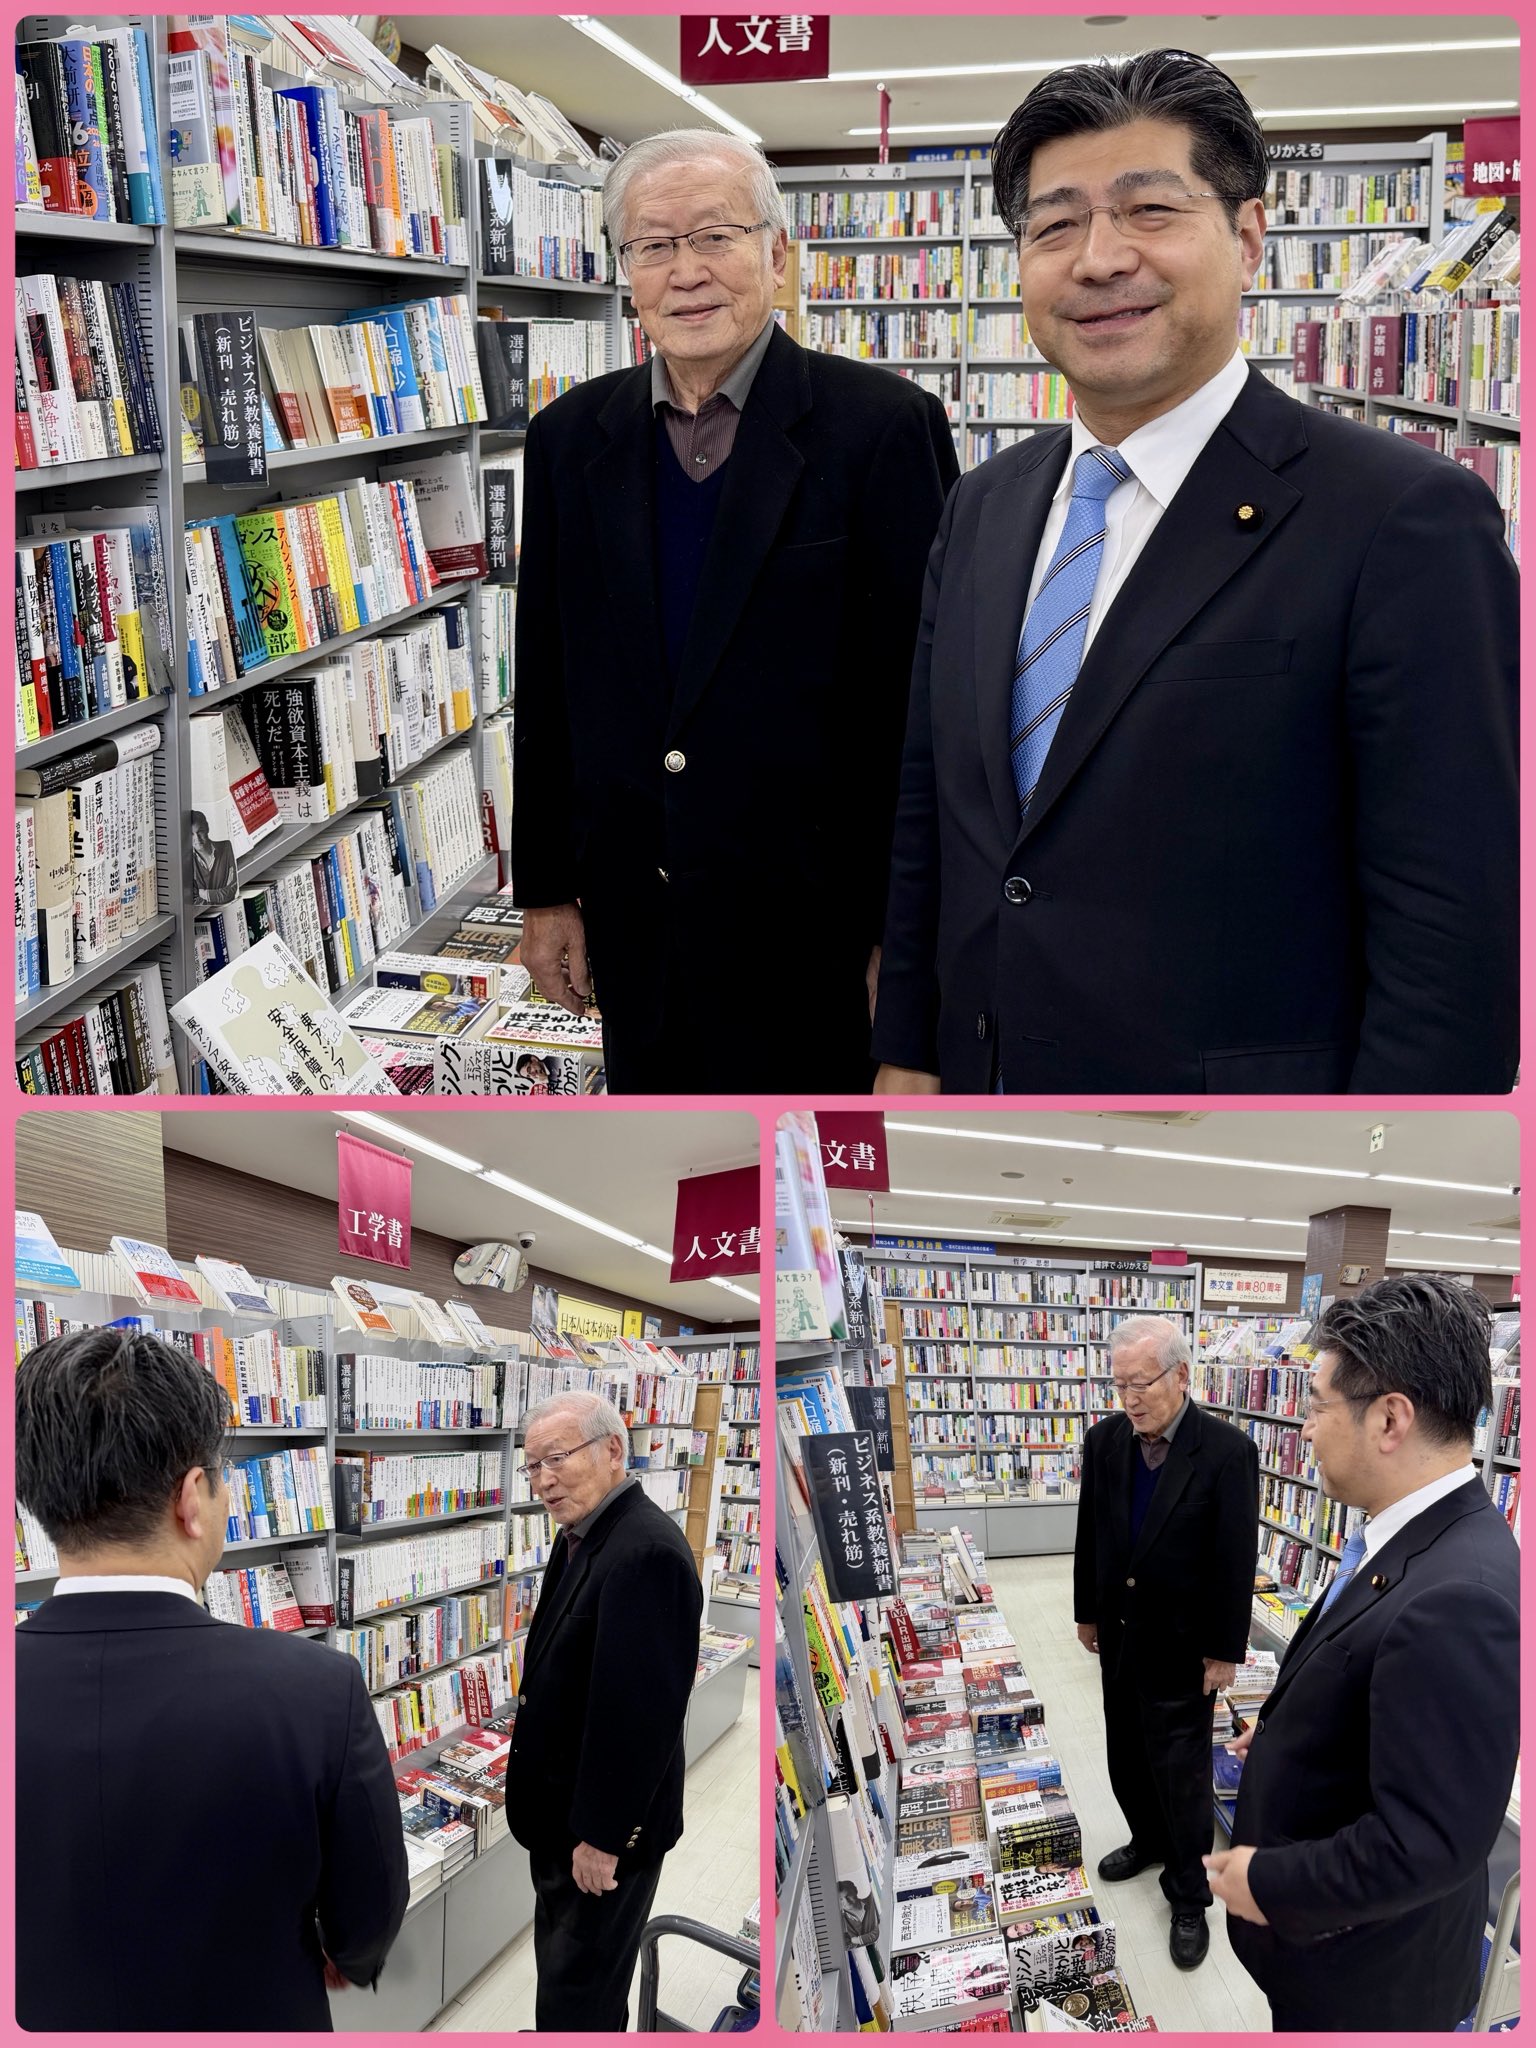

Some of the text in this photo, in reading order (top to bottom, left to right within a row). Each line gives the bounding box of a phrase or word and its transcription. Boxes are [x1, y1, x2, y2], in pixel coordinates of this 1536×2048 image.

[698, 15, 814, 57] 人文書
[839, 166, 903, 180] 人文書
[508, 334, 524, 407] 選書 新刊
[1372, 324, 1386, 389] 作家別 さ行
[237, 316, 265, 476] ビジネス系教養新書
[488, 484, 508, 569] 選書系新刊
[262, 690, 284, 744] 死んだ
[285, 688, 314, 819] 強欲資本主義は
[508, 1010, 593, 1024] 株はもう
[266, 1006, 334, 1091] 安全保障の
[299, 1011, 346, 1076] 東アジア
[820, 1139, 877, 1172] 文書
[346, 1208, 404, 1249] 工学書
[683, 1226, 761, 1264] 人文書
[888, 1250, 928, 1262] 人文書
[1094, 1260, 1149, 1271] 書評でふりかえる
[1209, 1279, 1283, 1294] 泰文堂 創業80周年
[340, 1364, 352, 1425] 選書系新刊
[873, 1396, 890, 1455] 選書 新刊
[852, 1437, 895, 1592] ビジネス系教養新書
[339, 1567, 350, 1621] 選書系新刊
[895, 1617, 916, 1661] NR出版会
[899, 1798, 951, 1818] 潤日
[990, 1800, 1044, 1818] 豊田章男
[999, 1872, 1057, 1894] 株はもう
[1002, 1878, 1069, 1904] 下がらない
[900, 1903, 913, 1943] 西洋の敗北
[899, 1973, 927, 2018] 秩序
